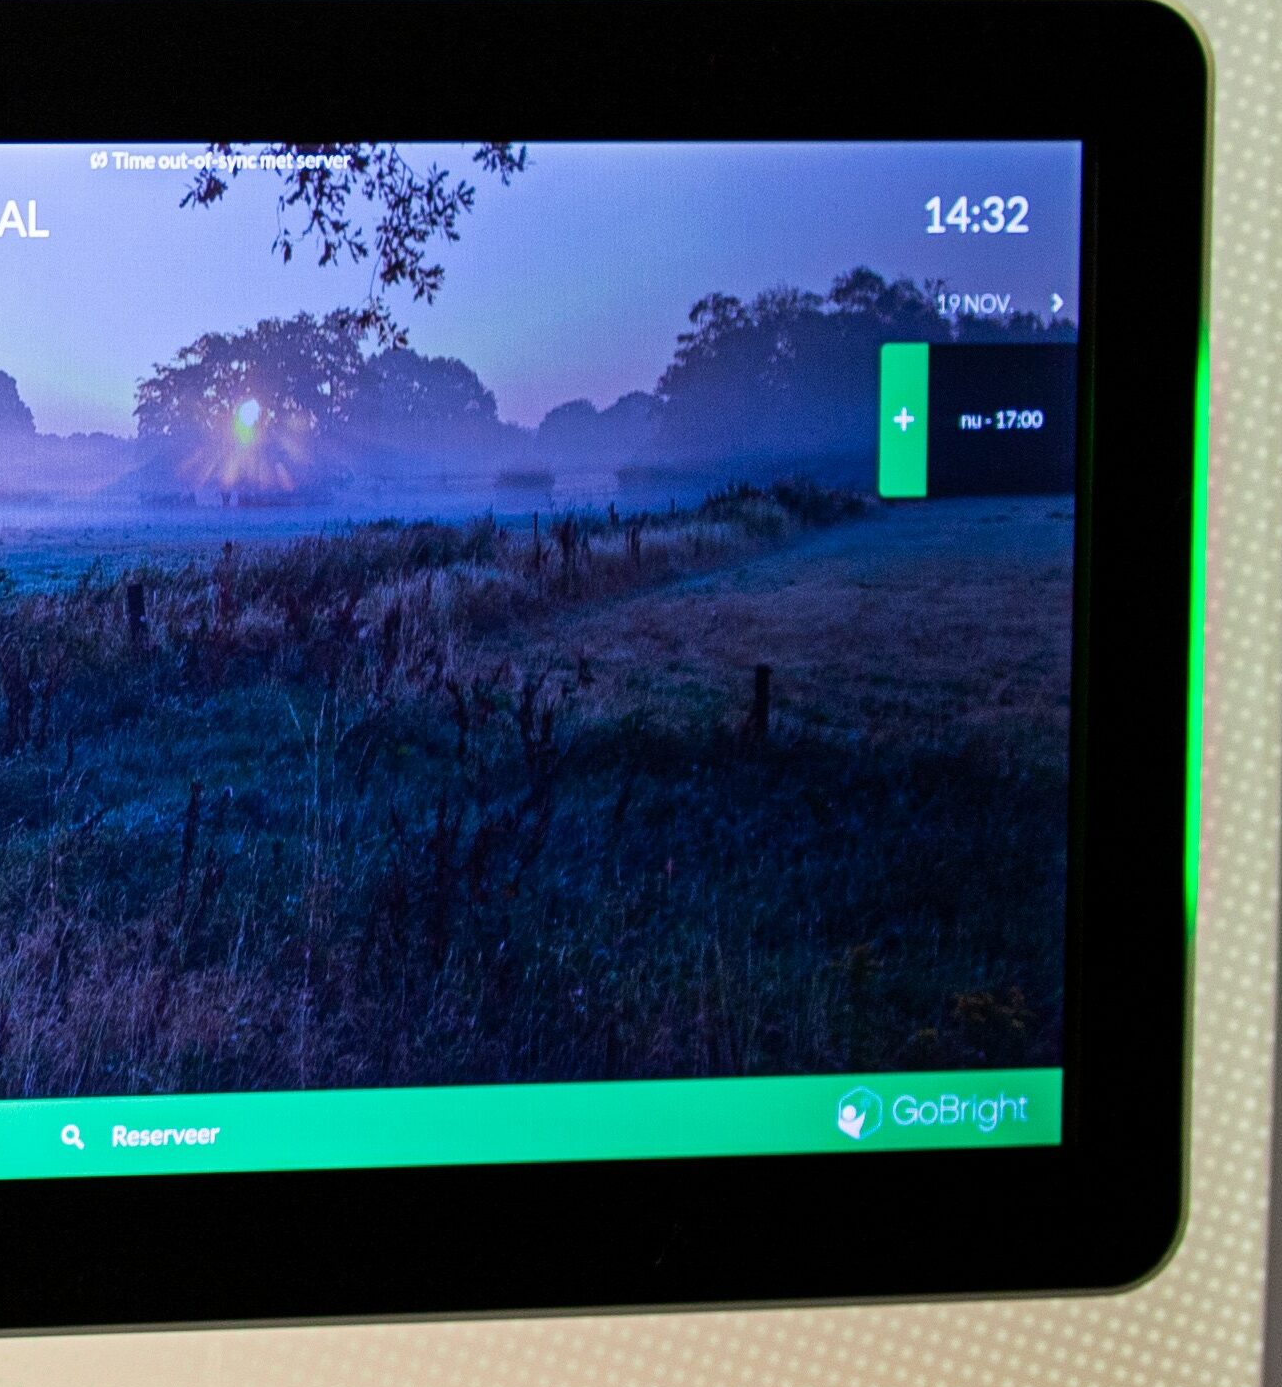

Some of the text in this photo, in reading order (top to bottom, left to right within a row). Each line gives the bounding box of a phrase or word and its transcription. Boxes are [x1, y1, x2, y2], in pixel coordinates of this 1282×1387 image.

[112, 151, 351, 174] Time out-of-sync met server
[925, 196, 1030, 234] 14:32
[938, 293, 1014, 314] 19 NOV.
[961, 414, 982, 430] nu
[996, 410, 1043, 430] 17:00
[892, 1094, 1028, 1132] GoBright
[112, 1123, 220, 1148] Reserveer
